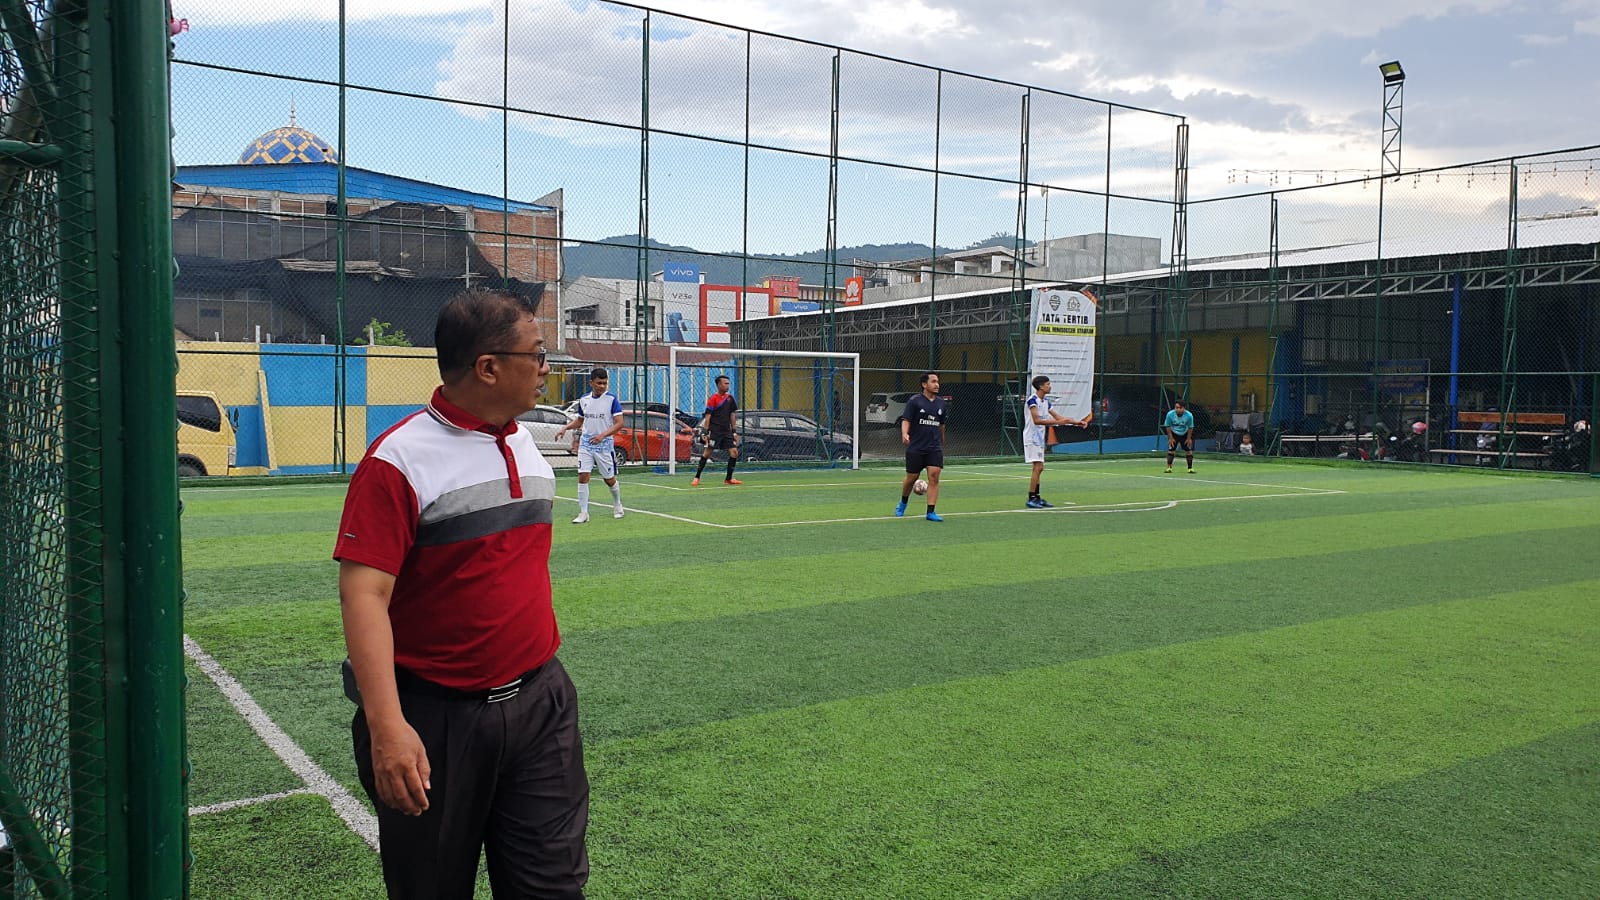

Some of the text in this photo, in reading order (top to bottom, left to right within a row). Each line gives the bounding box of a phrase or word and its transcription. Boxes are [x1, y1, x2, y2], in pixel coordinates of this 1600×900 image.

[670, 267, 694, 276] vivo
[1042, 313, 1088, 325] TATA TERTIB
